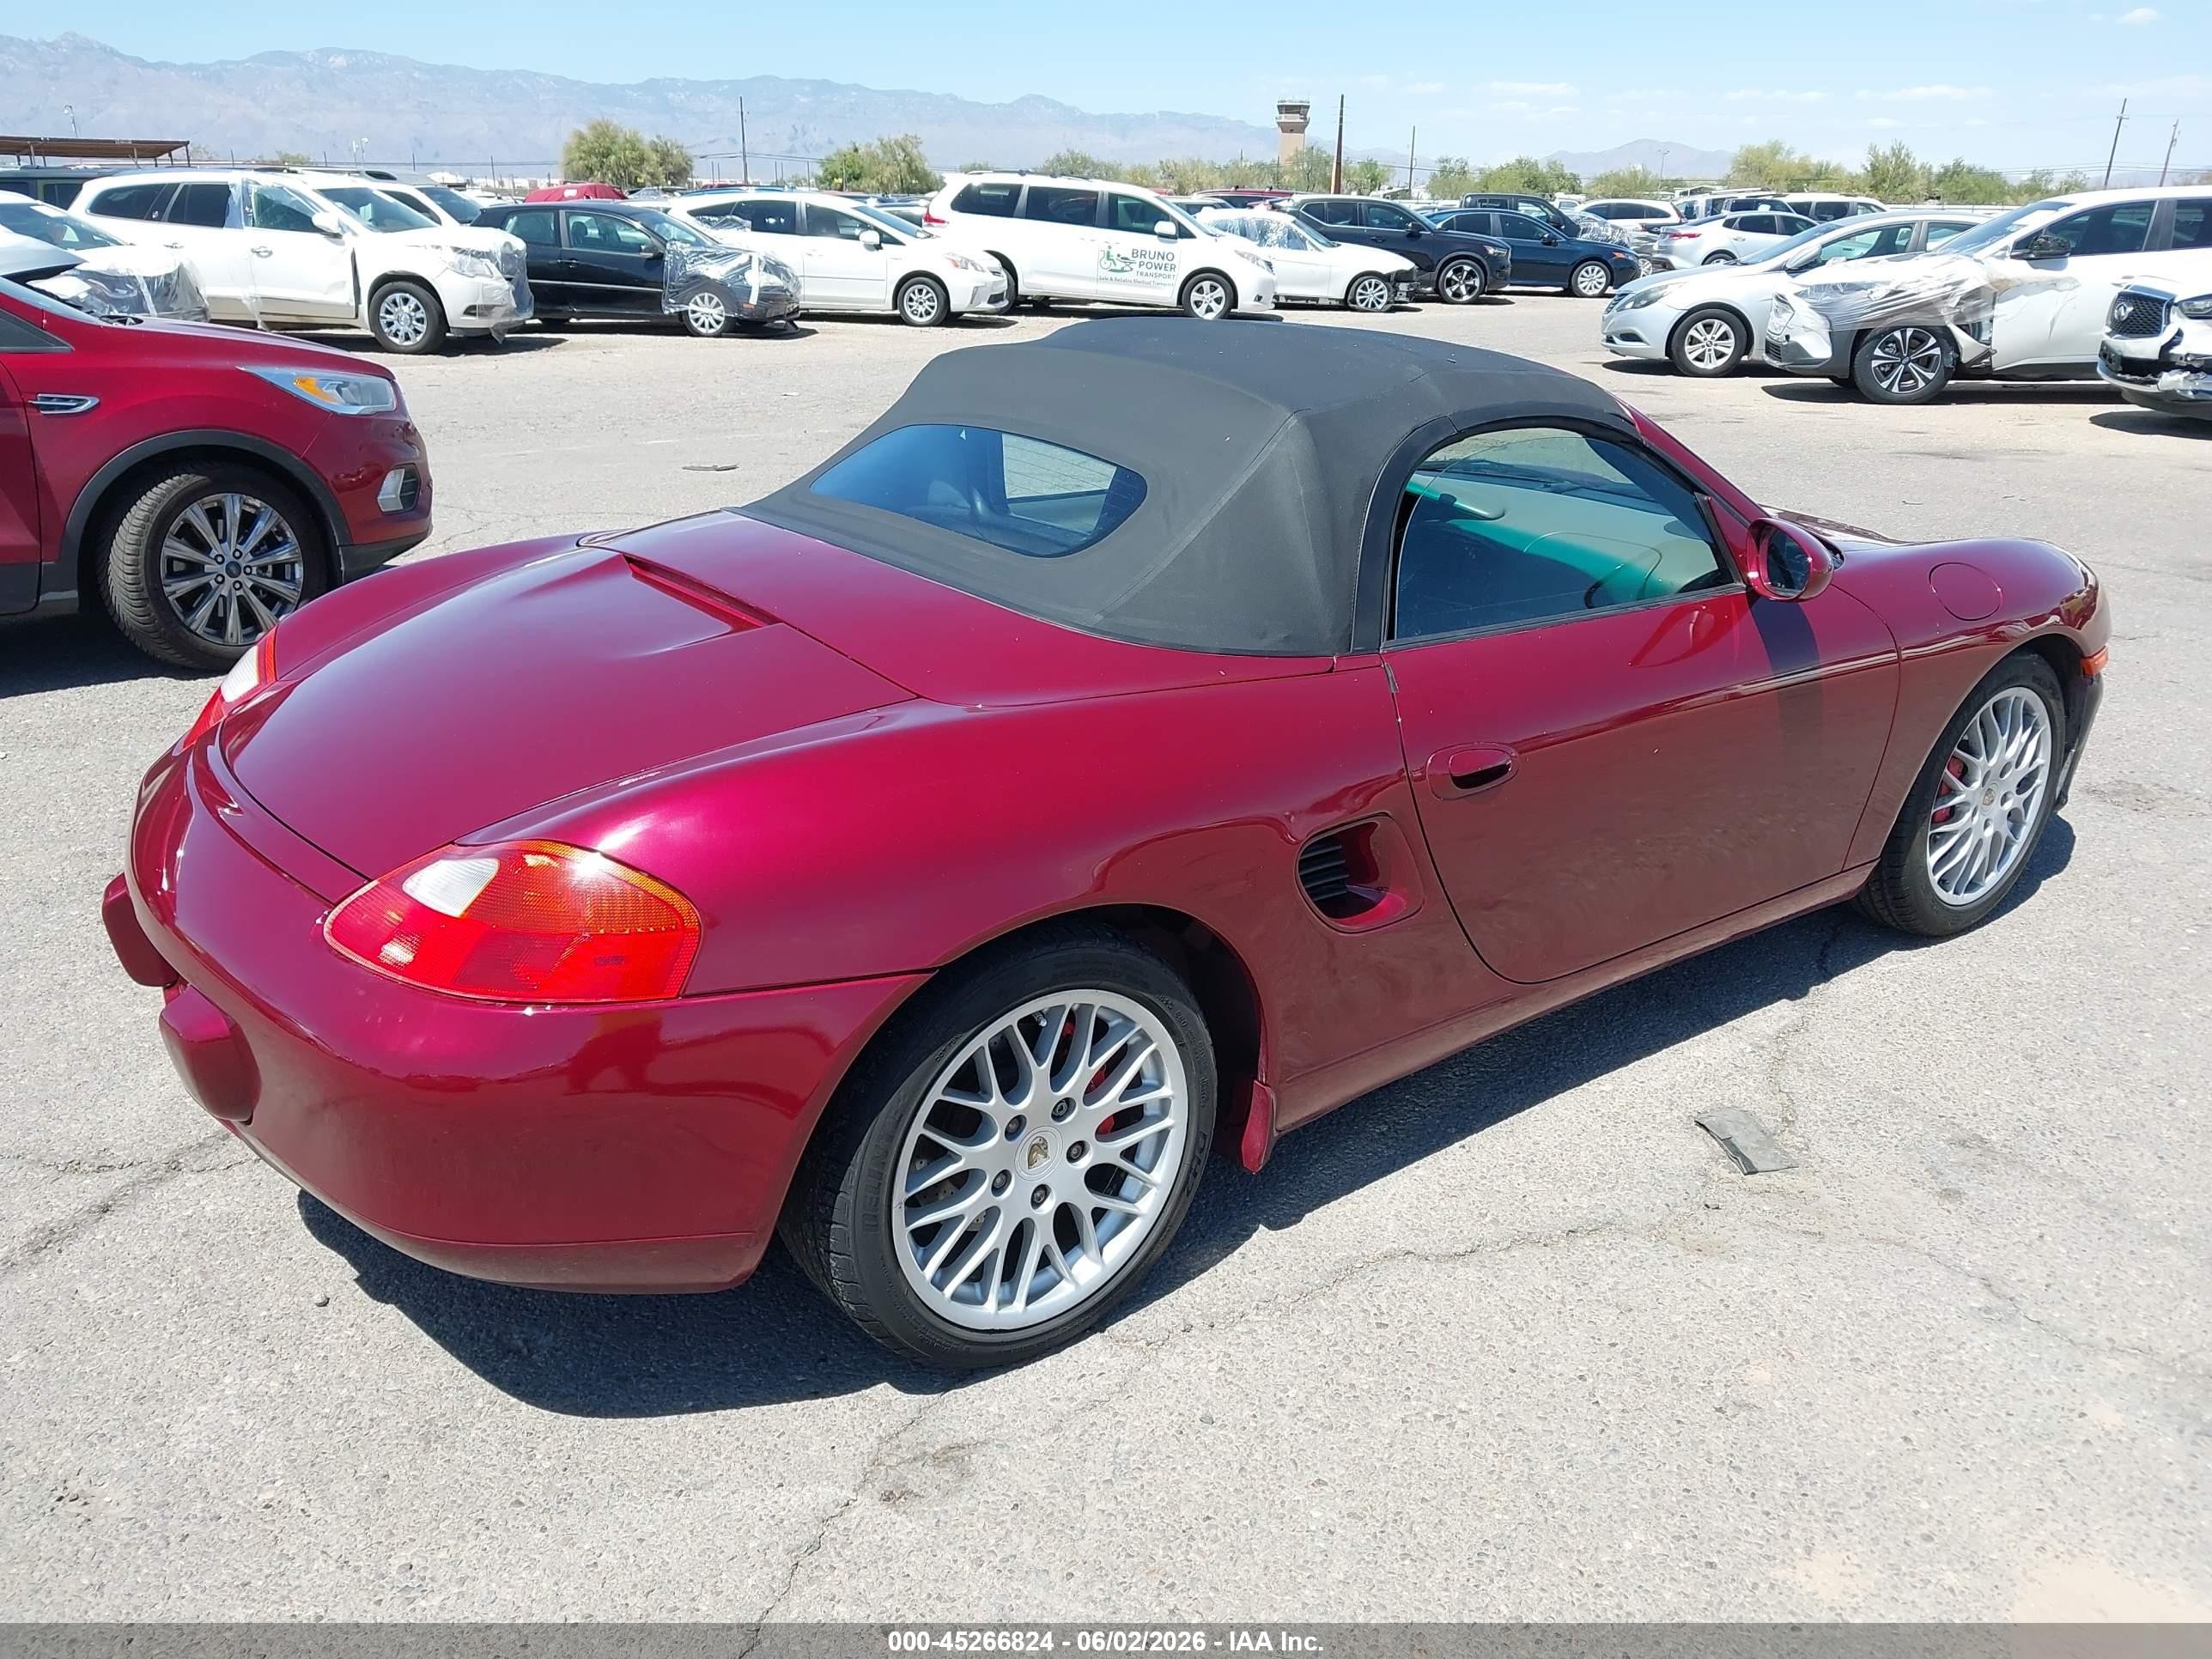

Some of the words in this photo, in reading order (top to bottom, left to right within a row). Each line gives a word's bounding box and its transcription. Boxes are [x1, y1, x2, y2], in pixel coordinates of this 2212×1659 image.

[1132, 248, 1175, 261] BRUNO
[1139, 260, 1176, 272] POWER
[1136, 270, 1176, 280] TRANSPORT
